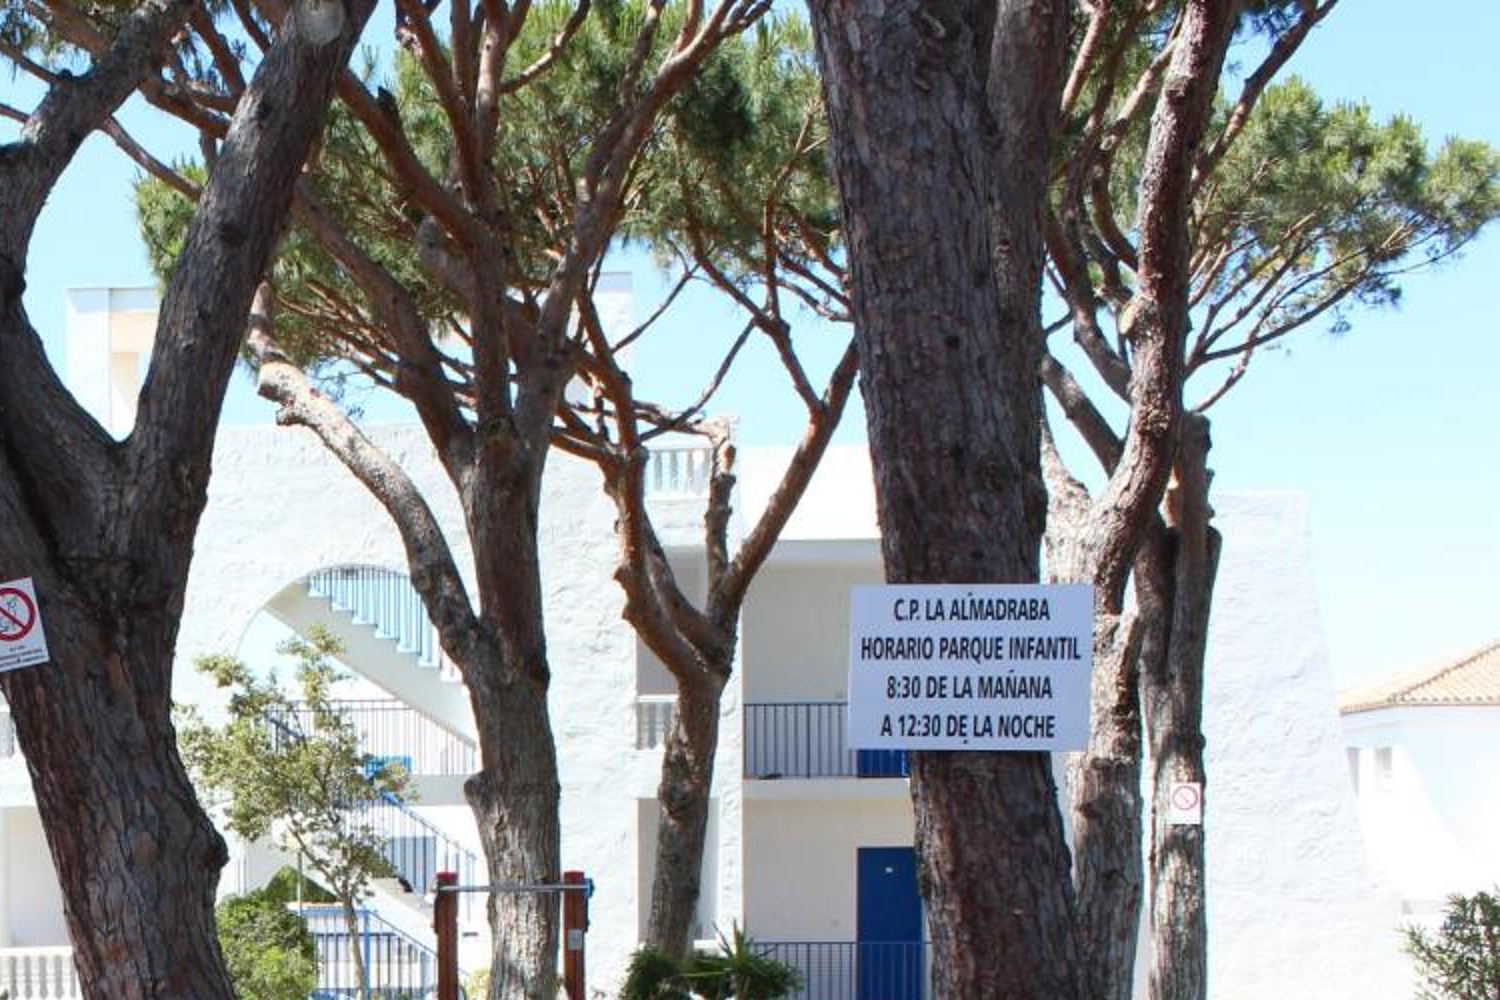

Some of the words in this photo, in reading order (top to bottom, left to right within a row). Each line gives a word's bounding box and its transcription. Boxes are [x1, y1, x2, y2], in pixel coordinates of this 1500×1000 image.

[893, 598, 920, 621] C.P.
[925, 598, 945, 621] LA
[949, 598, 1051, 621] ALMADRABA
[861, 637, 933, 660] HORARIO
[939, 637, 1004, 664] PARQUE
[1009, 637, 1081, 660] INFANTIL
[886, 675, 921, 699] 8:30
[926, 675, 947, 699] DE
[952, 675, 973, 699] LA
[978, 669, 1053, 699] MAÑANA
[880, 714, 893, 737] A
[898, 714, 941, 737] 12:30
[946, 714, 968, 737] DE
[973, 714, 993, 737] LA
[997, 714, 1056, 739] NOCHE
